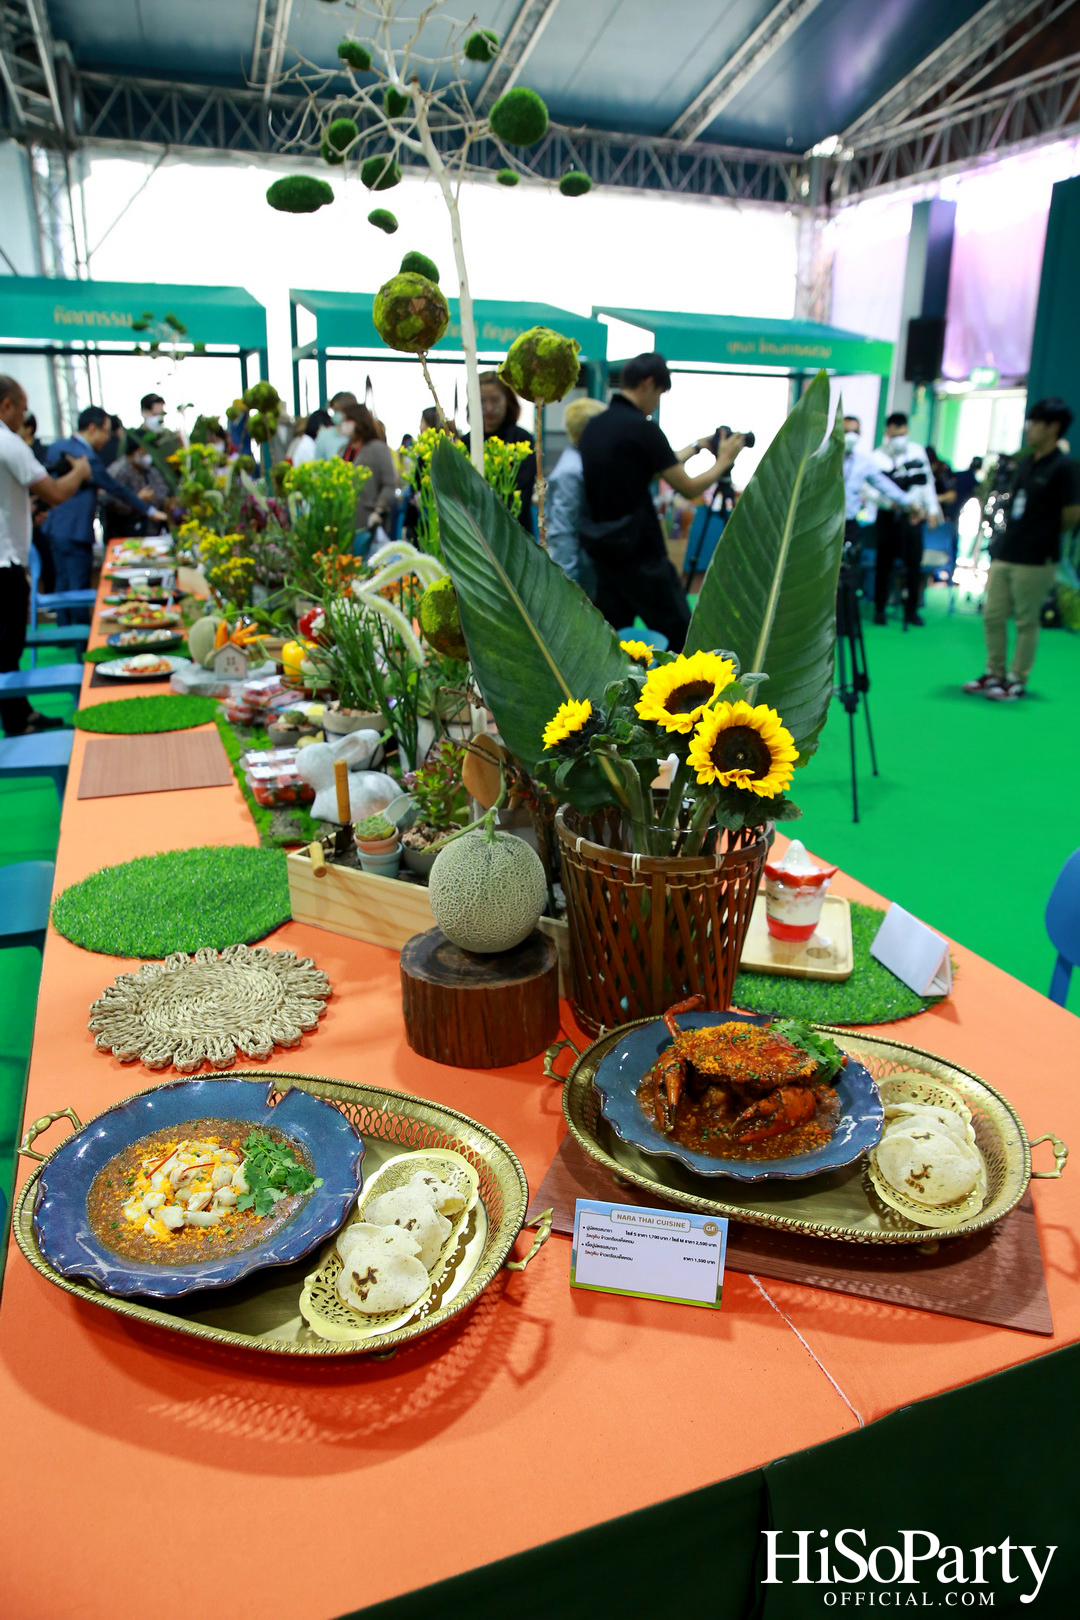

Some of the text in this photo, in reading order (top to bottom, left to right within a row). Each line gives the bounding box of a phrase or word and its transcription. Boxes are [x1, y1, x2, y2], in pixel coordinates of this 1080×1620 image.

[616, 1213, 686, 1229] NARA THAI CUISINE
